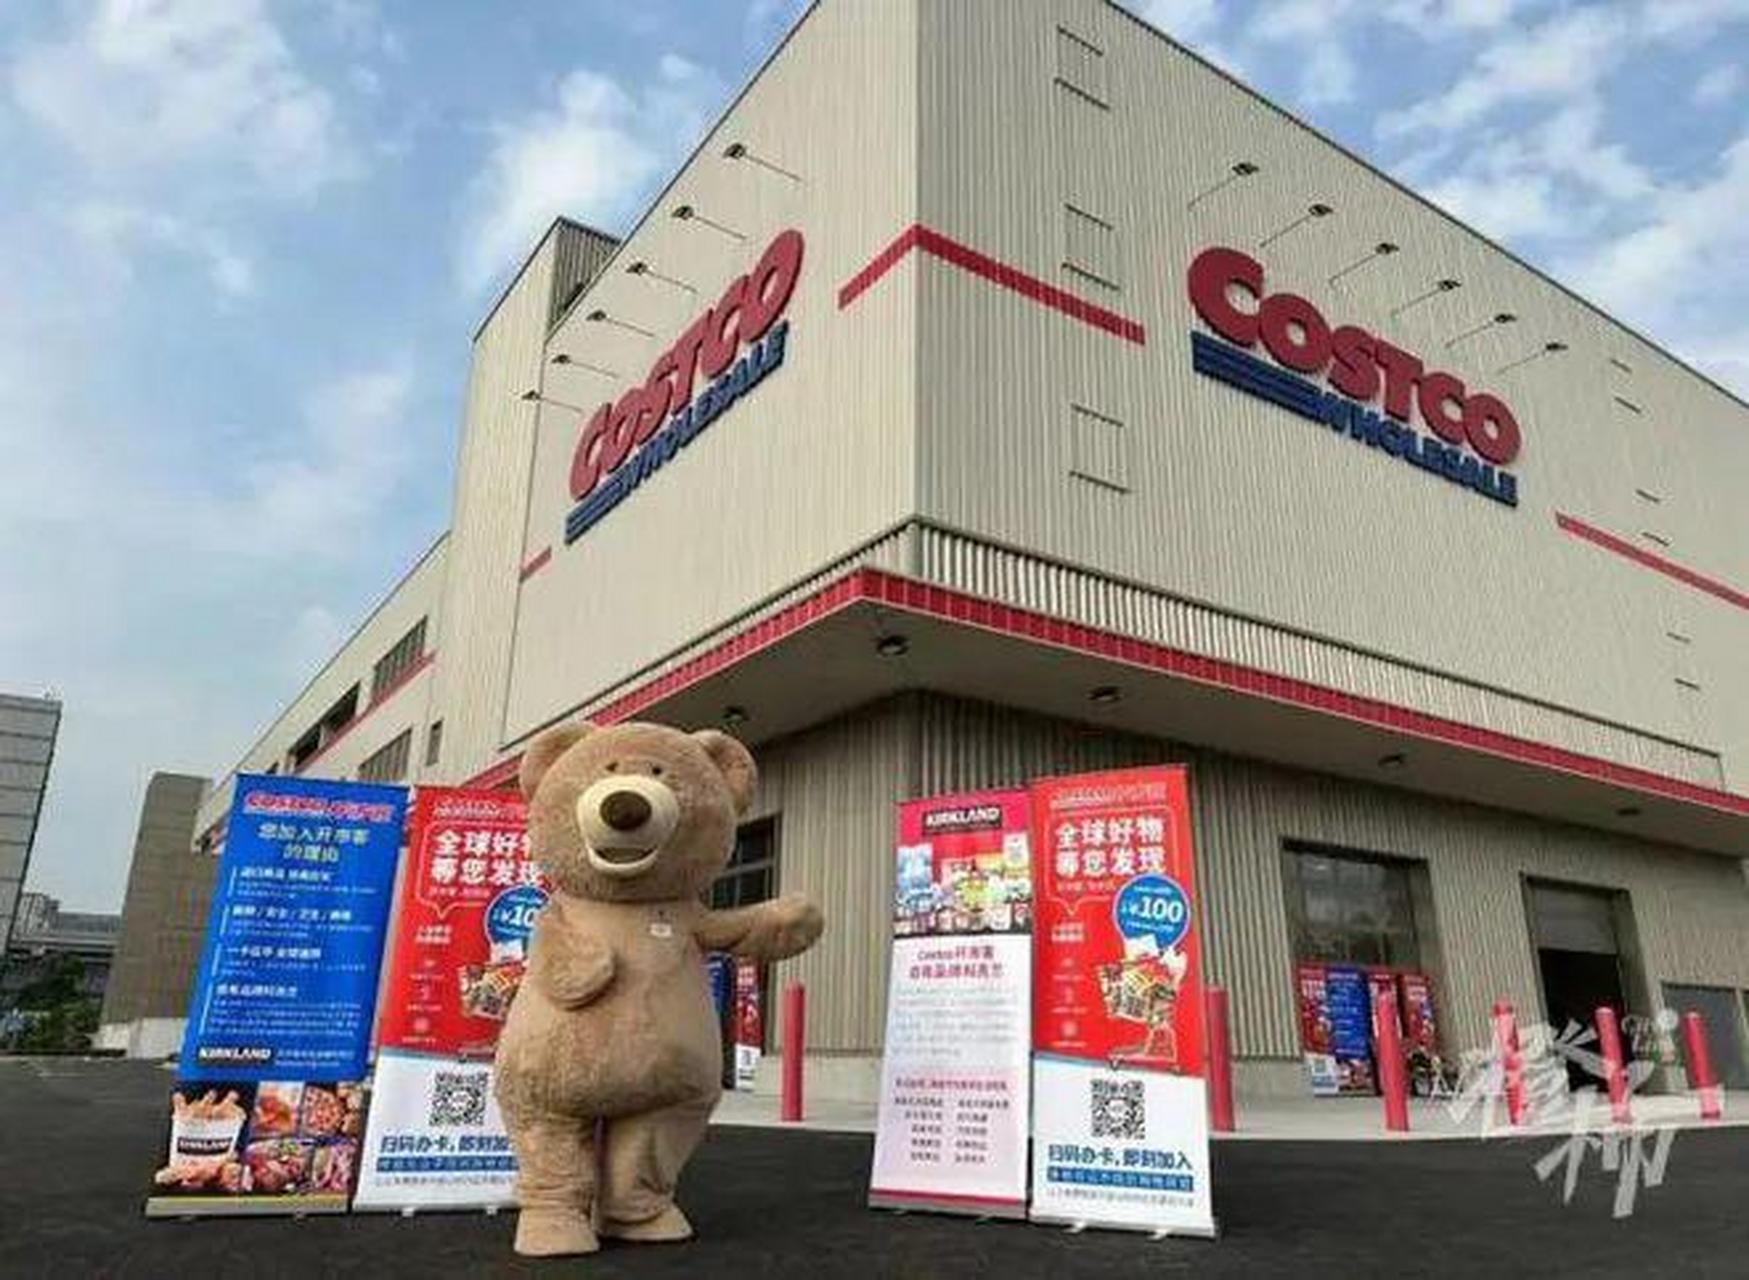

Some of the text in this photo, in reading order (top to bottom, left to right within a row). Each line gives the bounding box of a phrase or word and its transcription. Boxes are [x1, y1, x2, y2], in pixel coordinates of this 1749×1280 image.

[570, 229, 805, 502] COSTCO
[1188, 246, 1522, 467] COSTCO
[624, 319, 790, 492] WHOLESALE
[1320, 392, 1518, 508] WHOLESALE
[925, 807, 1000, 826] KIRKLAND
[1055, 815, 1165, 850] 全球好物
[433, 831, 531, 859] 全球好
[199, 1047, 271, 1061] KIRKLAND
[380, 1135, 509, 1153] 扫码办卡，即刻加
